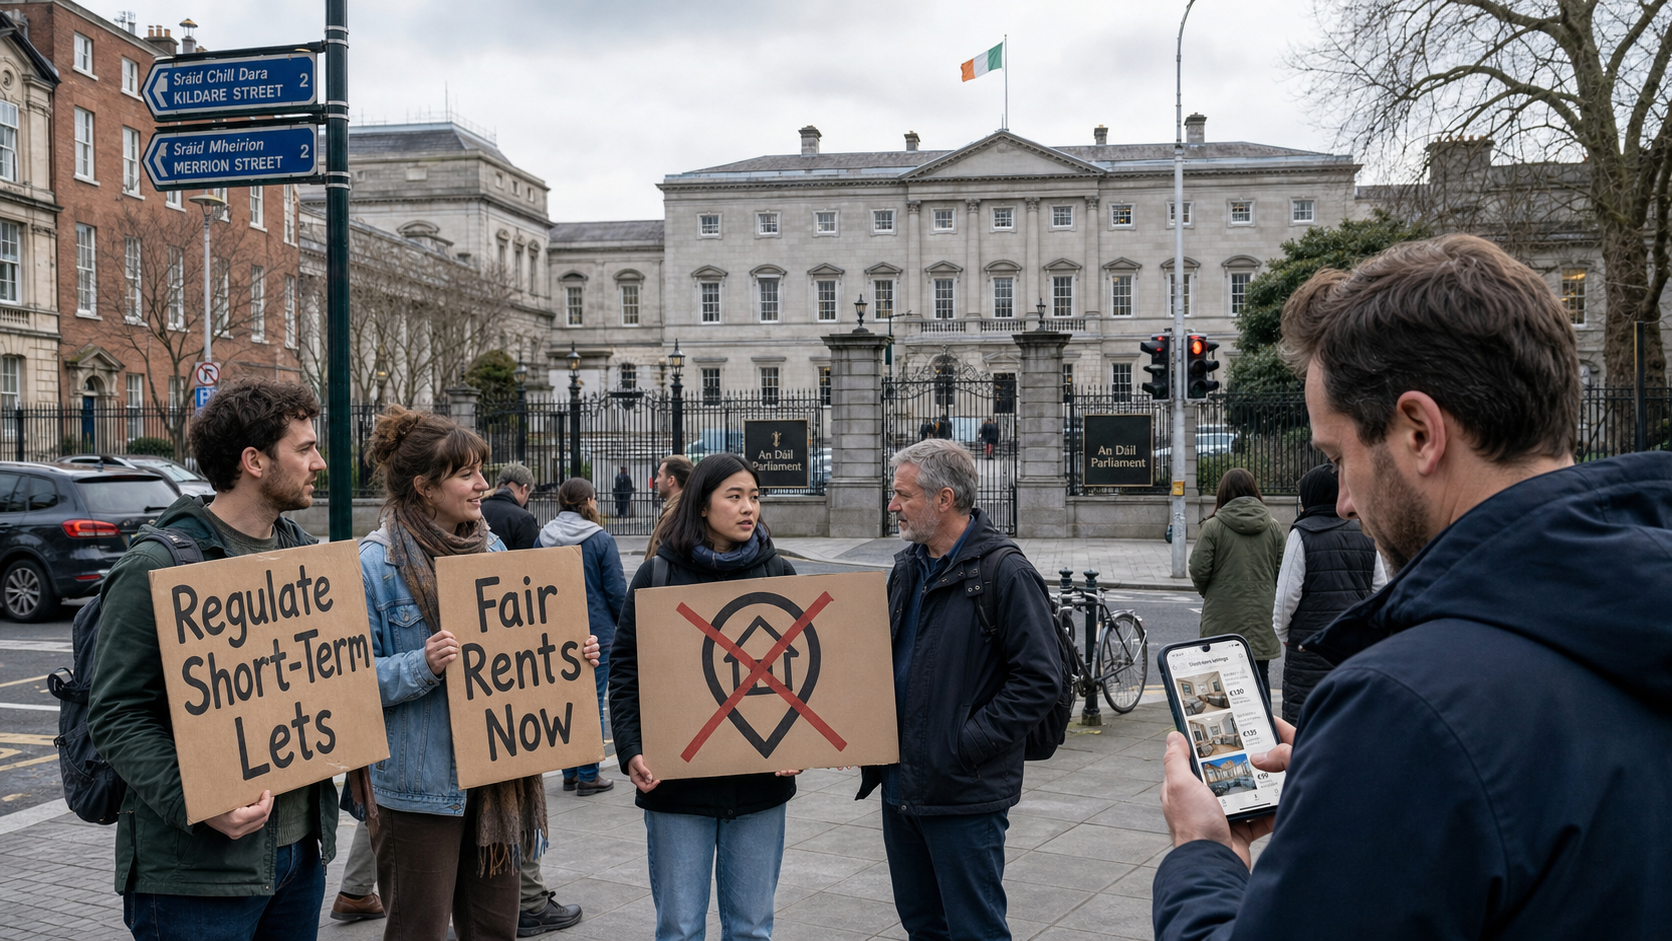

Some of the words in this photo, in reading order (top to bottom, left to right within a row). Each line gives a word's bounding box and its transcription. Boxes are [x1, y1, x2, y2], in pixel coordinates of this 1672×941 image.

[174, 71, 203, 86] Sráid
[207, 69, 234, 82] Chill
[239, 68, 267, 80] Dara
[300, 73, 308, 87] 2
[174, 88, 227, 104] KILDARE
[233, 84, 283, 100] STREET
[174, 141, 204, 155] Sráid
[209, 138, 264, 153] Mheirion
[300, 145, 309, 158] 2
[174, 159, 229, 175] MERRION
[234, 156, 283, 171] STREET
[758, 450, 771, 459] An
[1098, 446, 1112, 455] An
[1116, 445, 1136, 455] Dáil
[752, 461, 802, 471] Parliament
[1091, 457, 1146, 467] Parliament
[172, 565, 333, 648] Regulate
[475, 575, 558, 633] Fair
[181, 629, 370, 715] Short-Term
[461, 633, 581, 700] Rents
[485, 702, 573, 761] Now
[235, 701, 336, 781] Lets
